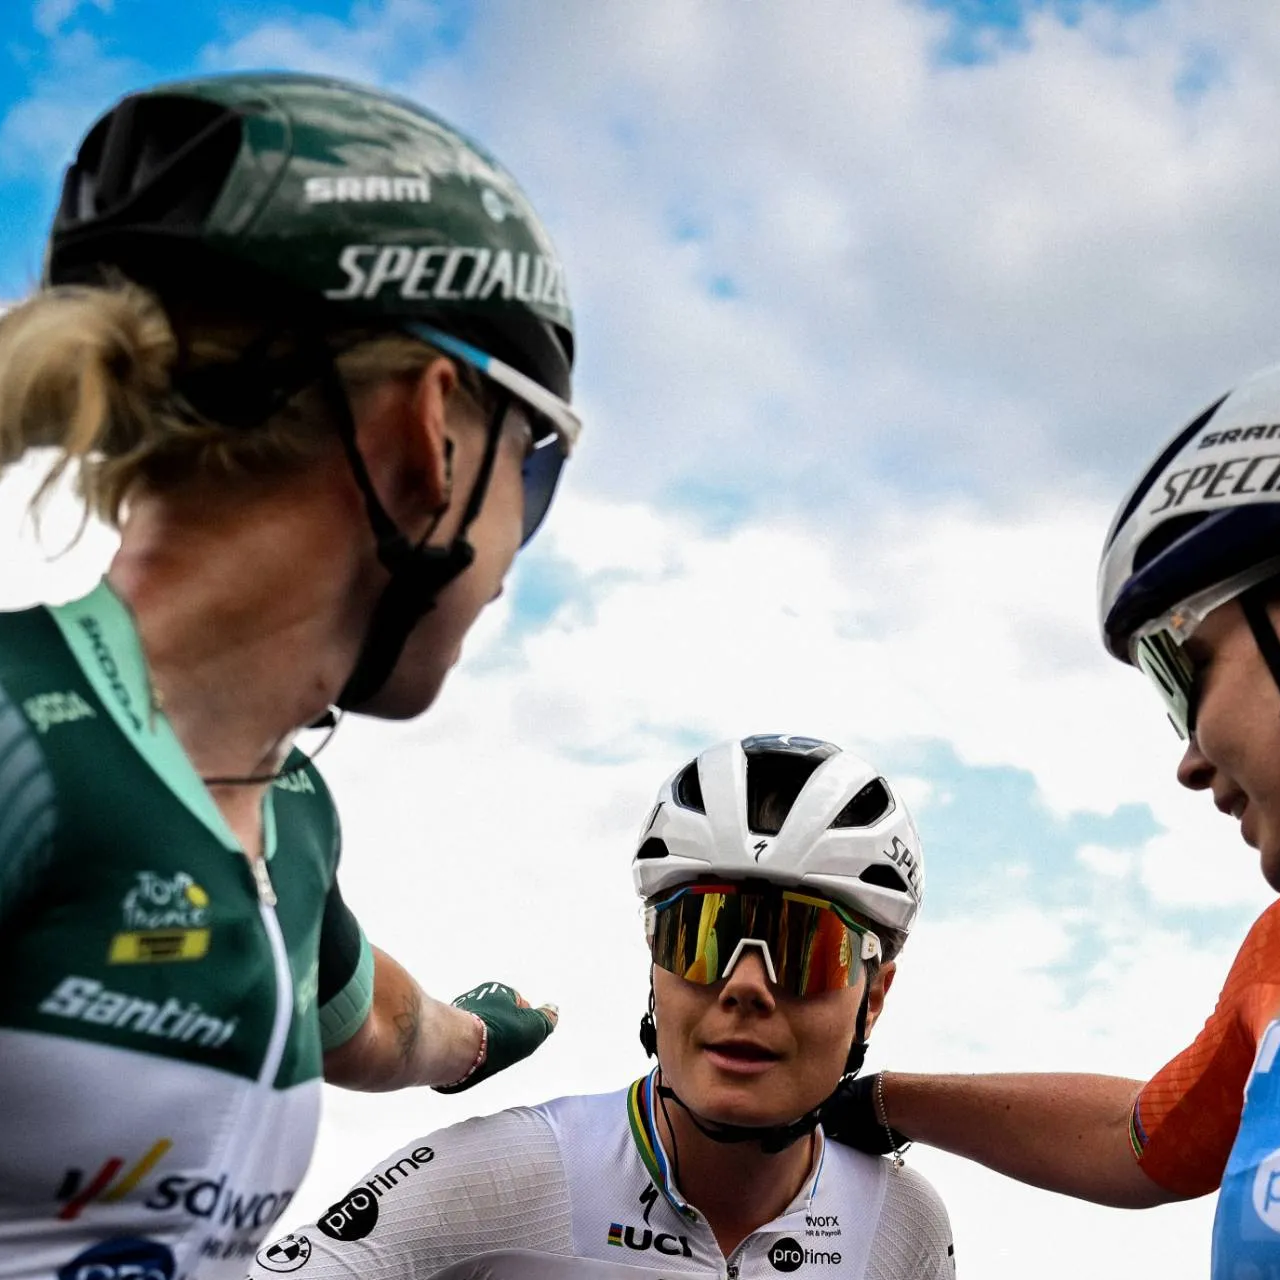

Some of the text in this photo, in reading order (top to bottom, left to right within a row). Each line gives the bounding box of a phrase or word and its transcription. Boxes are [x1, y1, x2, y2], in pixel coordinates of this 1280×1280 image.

[304, 176, 431, 203] SRAM
[40, 975, 241, 1048] Santini
[325, 1145, 436, 1236] protime
[623, 1225, 693, 1258] UCI
[773, 1248, 842, 1266] protime
